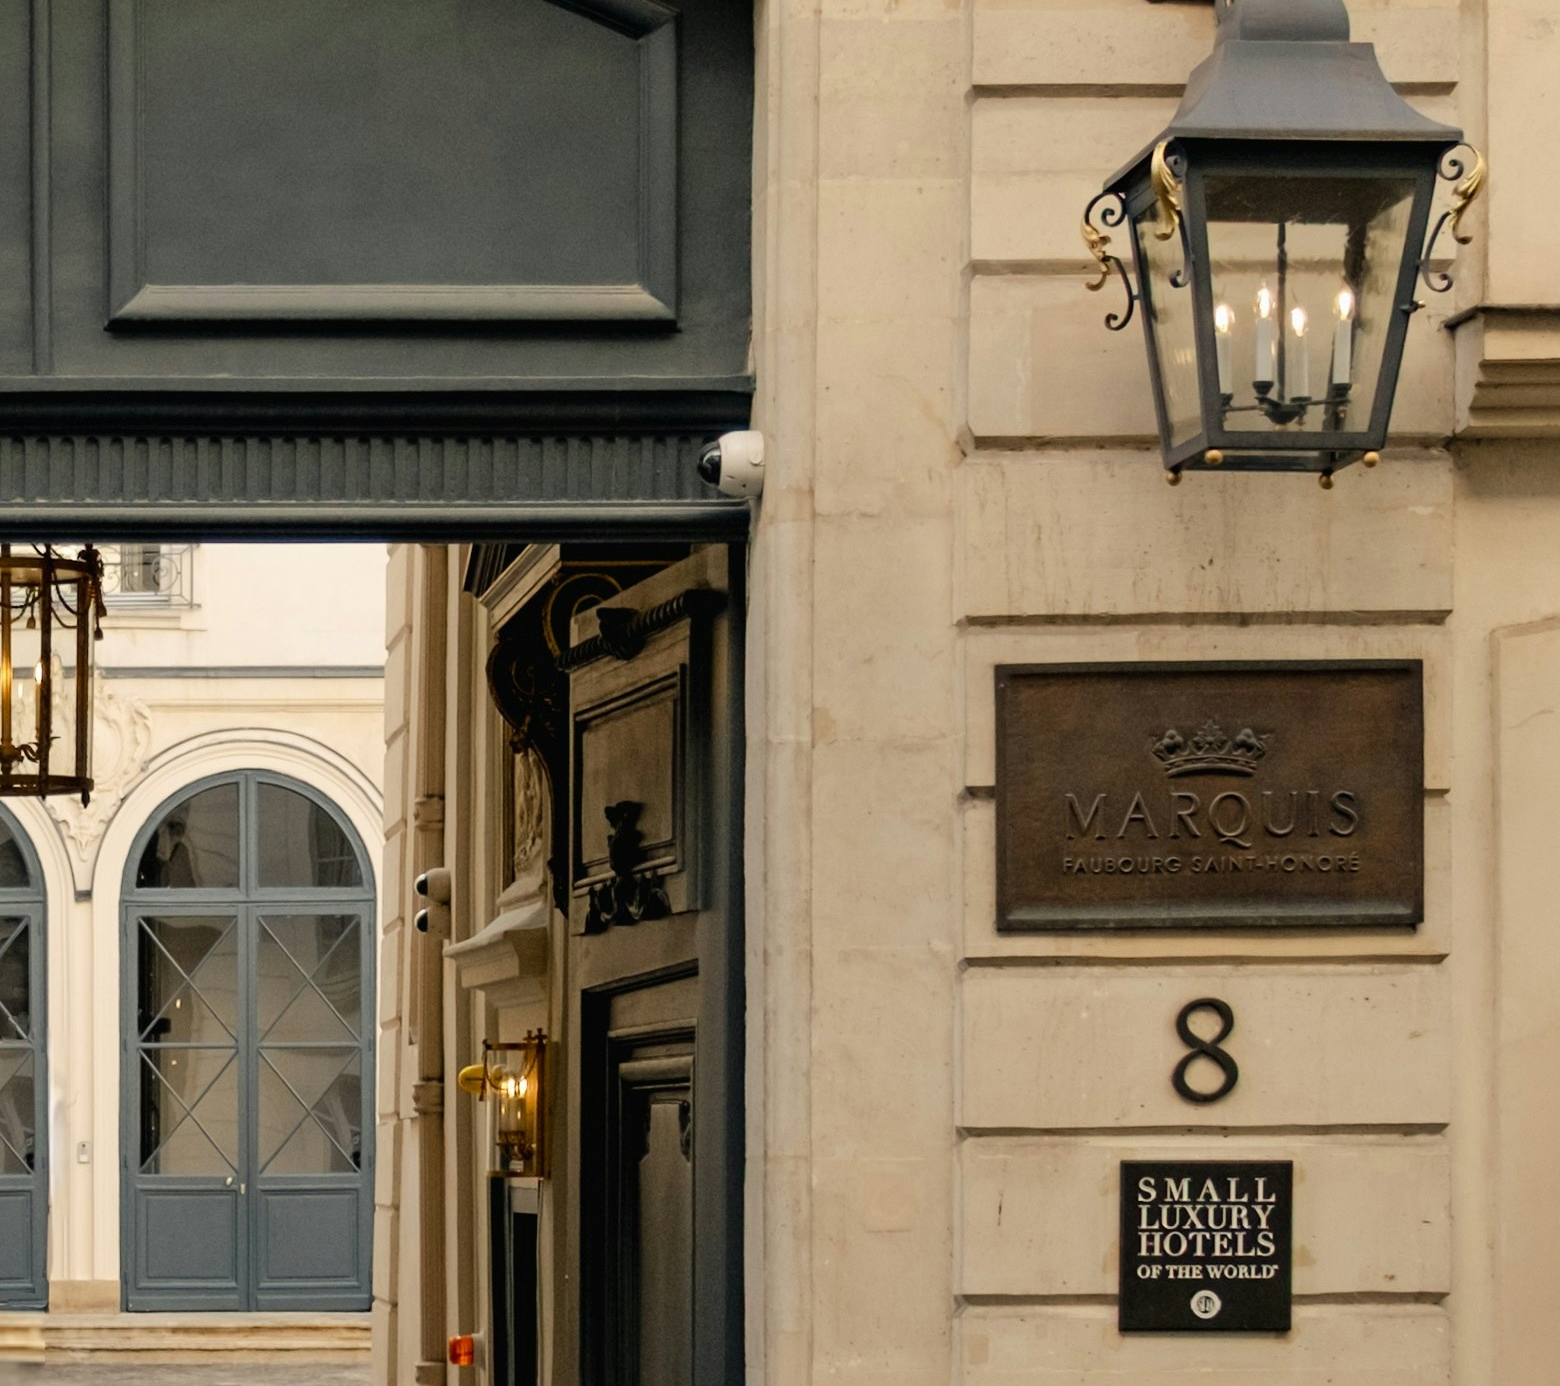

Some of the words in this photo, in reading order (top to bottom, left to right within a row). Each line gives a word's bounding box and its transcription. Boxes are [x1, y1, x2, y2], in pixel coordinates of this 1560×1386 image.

[1064, 790, 1360, 848] MARQUIS
[1063, 857, 1181, 874] FAUBOURG
[1191, 852, 1360, 872] SAINT-HONORÉ
[1171, 997, 1238, 1104] 8
[1138, 1177, 1276, 1202] SMALL
[1138, 1205, 1275, 1230] LUXURY
[1138, 1232, 1276, 1257] HOTELS
[1137, 1265, 1162, 1279] OF
[1166, 1265, 1202, 1279] THE
